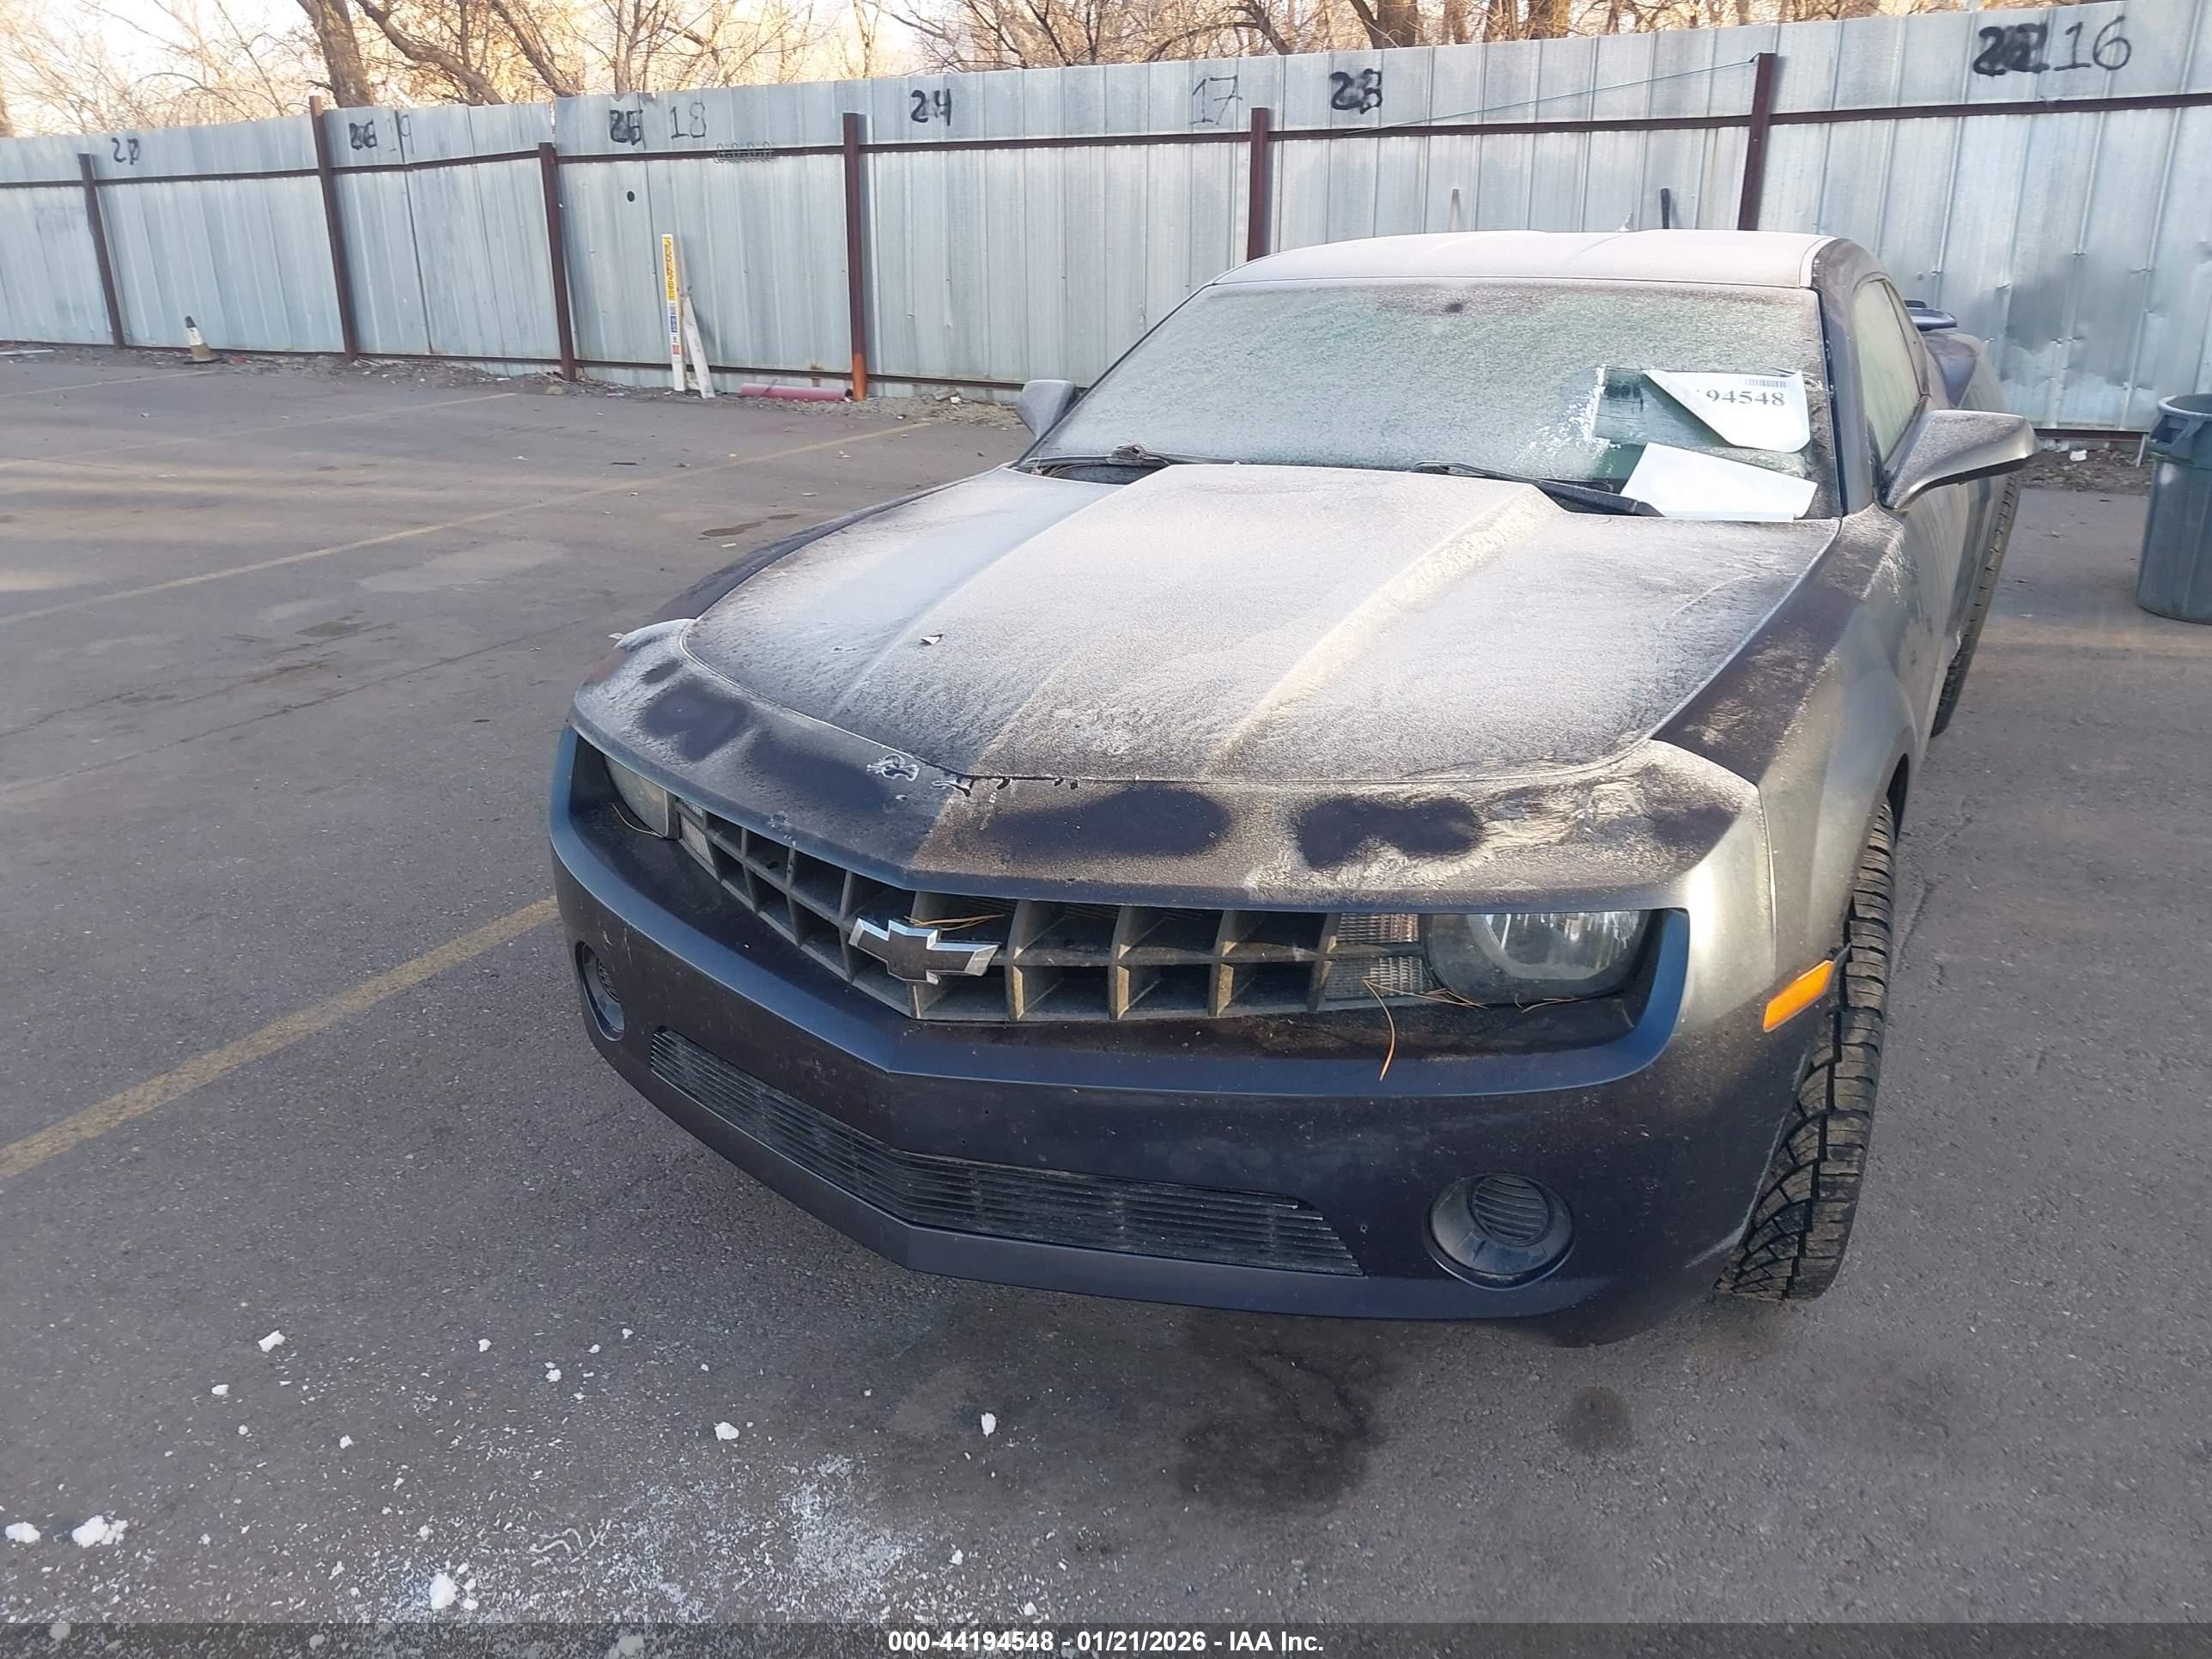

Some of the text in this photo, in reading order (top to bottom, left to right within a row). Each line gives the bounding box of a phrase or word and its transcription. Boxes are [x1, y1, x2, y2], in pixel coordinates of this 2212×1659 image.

[2053, 15, 2131, 71] 16
[670, 100, 707, 140] 18
[910, 88, 951, 127] 24
[1705, 388, 1786, 407] 94548
